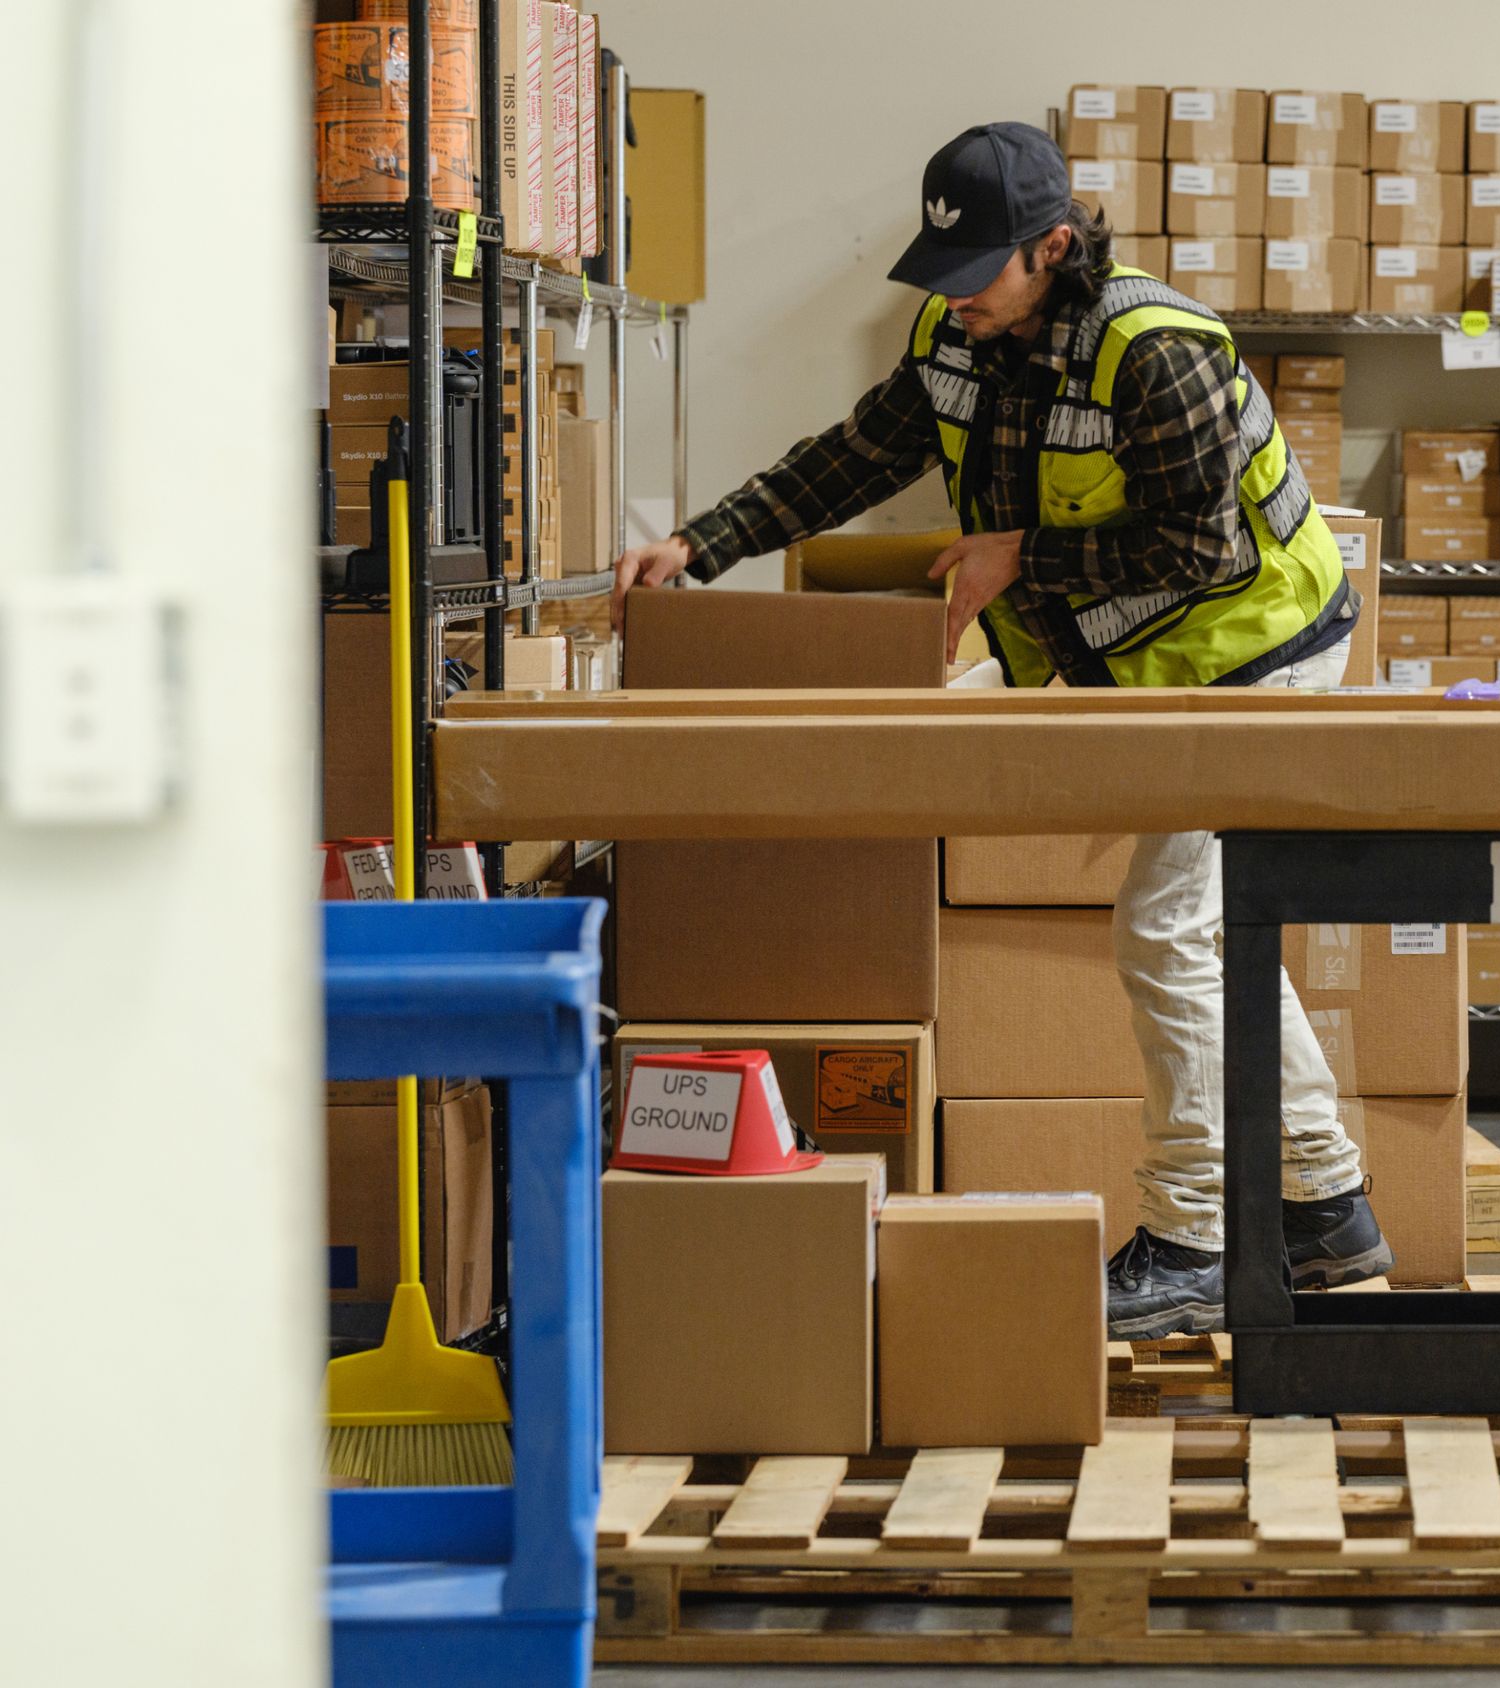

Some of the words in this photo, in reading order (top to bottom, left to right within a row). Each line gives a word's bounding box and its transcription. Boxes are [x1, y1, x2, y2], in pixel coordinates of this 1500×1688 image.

[503, 73, 516, 110] THIS
[503, 115, 517, 153] SIDE
[504, 157, 517, 179] UP
[343, 393, 369, 402] Skydio
[341, 451, 366, 460] Skydio
[663, 1073, 709, 1097] UPS
[630, 1105, 728, 1133] GROUND
